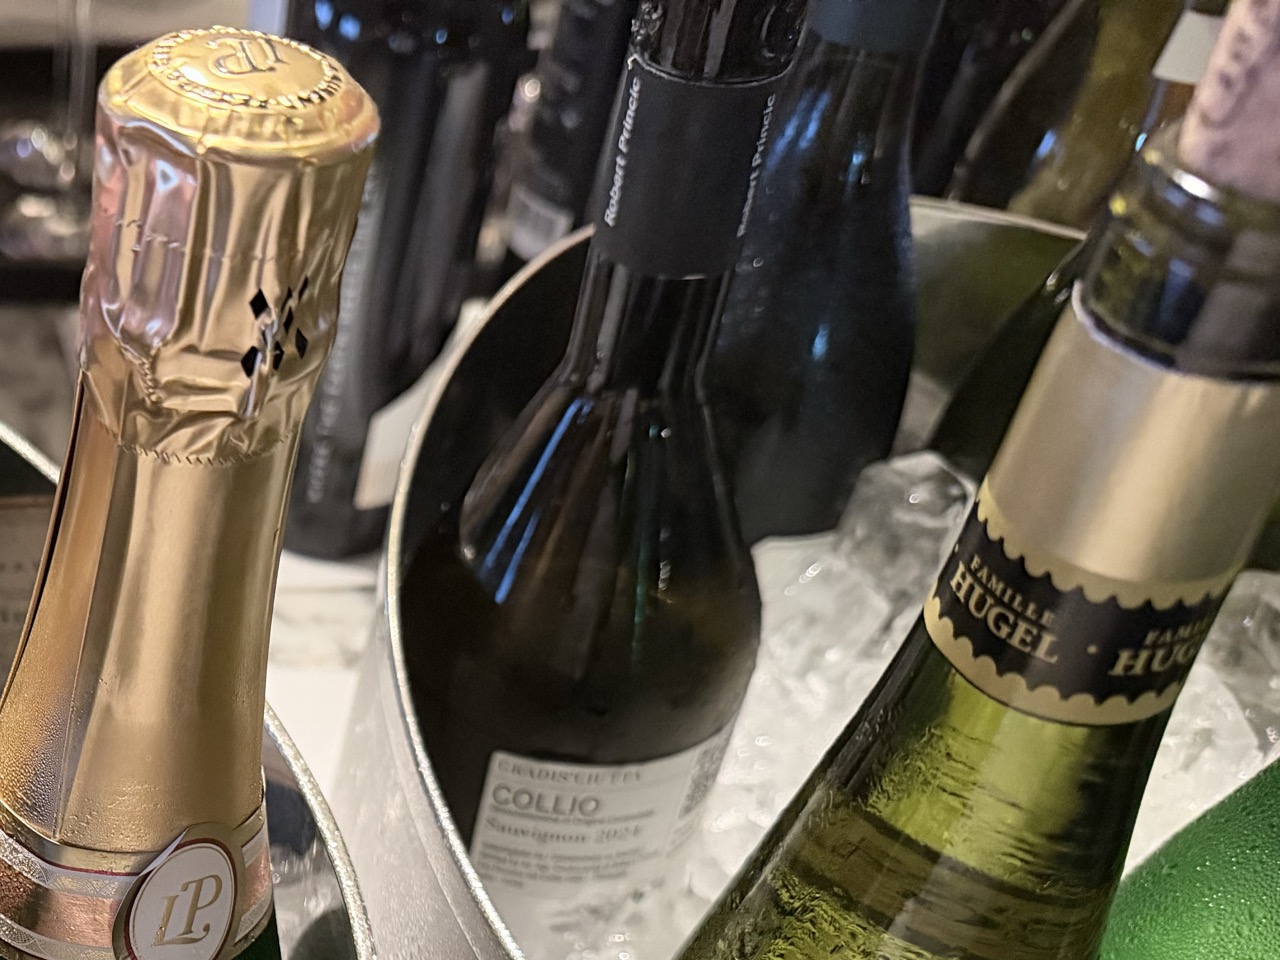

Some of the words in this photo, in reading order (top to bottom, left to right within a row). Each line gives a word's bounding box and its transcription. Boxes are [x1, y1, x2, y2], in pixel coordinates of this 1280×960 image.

[604, 154, 627, 227] Robert
[949, 560, 1059, 665] HUGEL
[969, 554, 1056, 626] FAMILLE
[492, 781, 601, 818] COLLIO
[151, 873, 224, 947] LP
